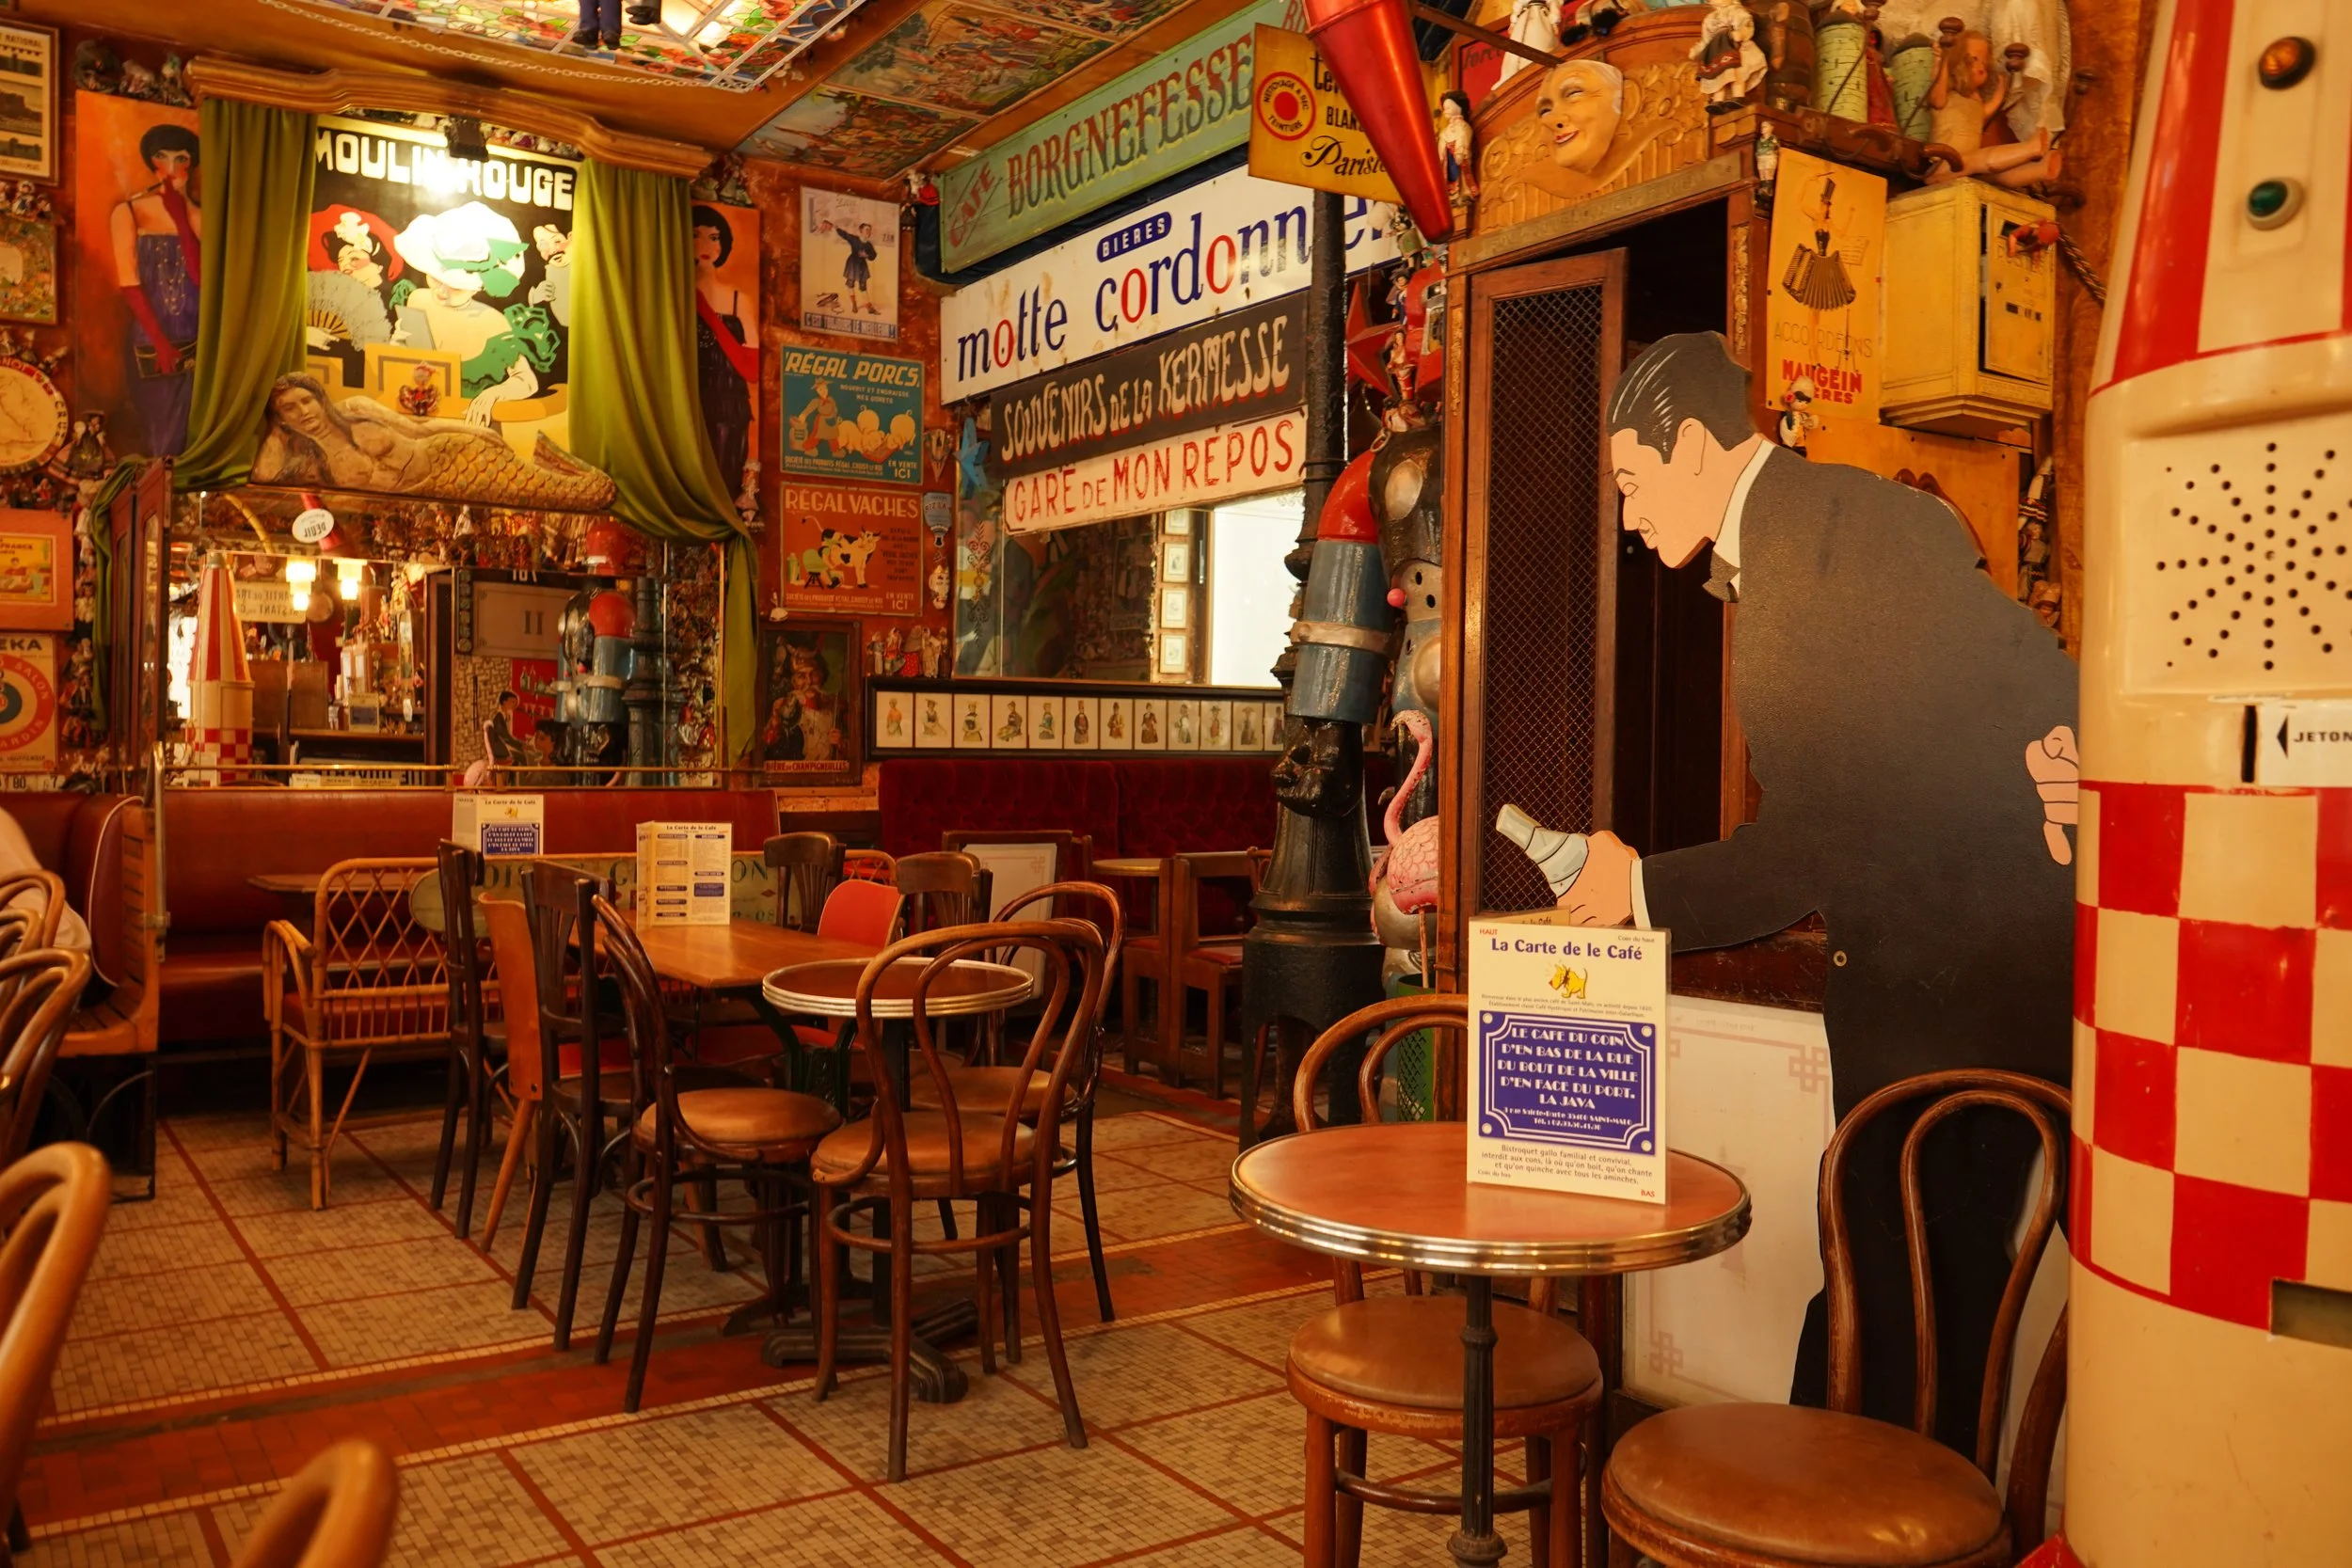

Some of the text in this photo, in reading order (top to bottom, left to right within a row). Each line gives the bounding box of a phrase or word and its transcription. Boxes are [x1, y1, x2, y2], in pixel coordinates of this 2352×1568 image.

[1008, 33, 1254, 220] BORGNEFESSE
[1267, 115, 1303, 132] TEINTURE
[315, 130, 574, 212] MOULIN ROUGE
[1102, 216, 1167, 258] BIÈRES
[957, 284, 1069, 383] motte
[1001, 373, 1106, 462] SOUVENIRS
[1158, 315, 1290, 415] KERMESSE
[895, 467, 911, 479] ICI
[1014, 467, 1077, 523] GARE
[1082, 478, 1107, 510] DE
[1112, 446, 1171, 504] MON
[785, 489, 847, 514] RÉGAL
[849, 495, 919, 518] VACHES
[892, 600, 908, 610] ICI
[1491, 938, 1643, 959] La Carte de le Café
[1511, 1027, 1528, 1038] LE
[1568, 1032, 1588, 1044] DU
[1590, 1034, 1625, 1047] COIN
[1502, 1043, 1633, 1065] D'EN BAS DE LA RUE
[1497, 1059, 1639, 1083] DU BOUT DE LA VILLE
[1501, 1076, 1636, 1100] D'EN FACE DU PORT.
[1539, 1094, 1596, 1110] LA JAVA
[1481, 1151, 1508, 1161] interdit
[1565, 1160, 1584, 1168] qu'on
[1587, 1163, 1604, 1172] boit,
[1605, 1165, 1626, 1174] qu'on
[1628, 1168, 1653, 1178] chante
[1502, 1144, 1538, 1156] Bistroquet
[1539, 1148, 1558, 1158] gallo
[1559, 1150, 1586, 1160] familial
[1598, 1156, 1632, 1166] convivial,
[1503, 1163, 1524, 1171] qu'on
[1525, 1165, 1554, 1174] quinche
[1574, 1169, 1590, 1178] tous
[1591, 1171, 1601, 1180] les
[1603, 1174, 1639, 1185] aminches.
[1640, 1189, 1656, 1197] BAS
